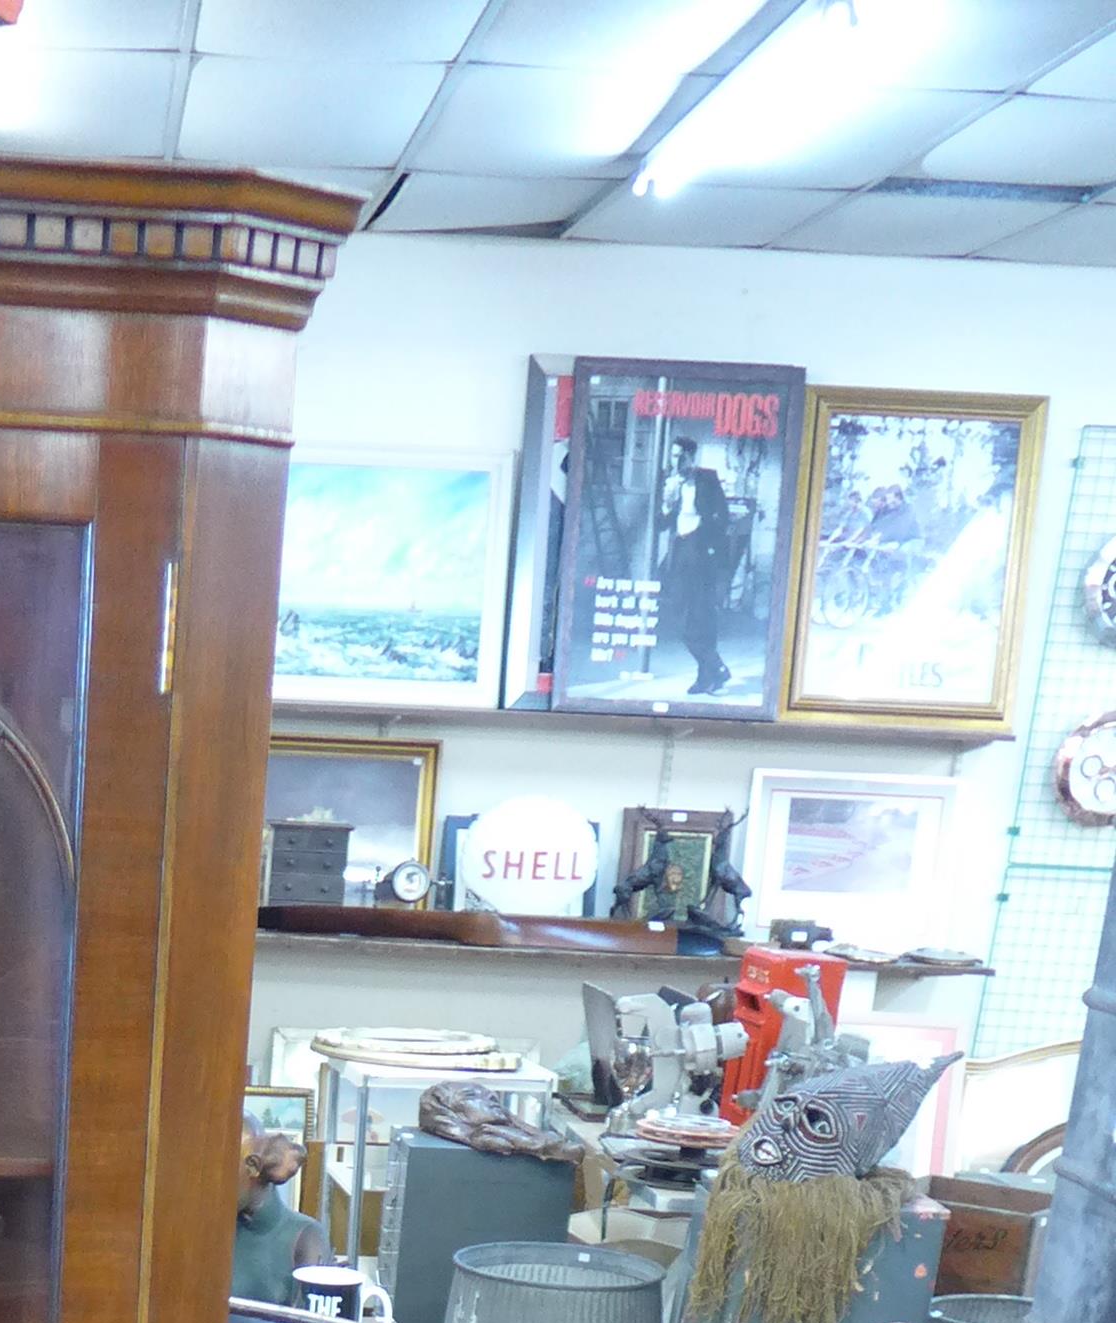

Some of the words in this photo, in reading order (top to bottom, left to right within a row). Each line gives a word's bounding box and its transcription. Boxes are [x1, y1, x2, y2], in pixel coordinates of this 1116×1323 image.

[714, 392, 780, 438] DOGS
[482, 850, 583, 880] SHELL
[307, 1293, 343, 1318] THE
